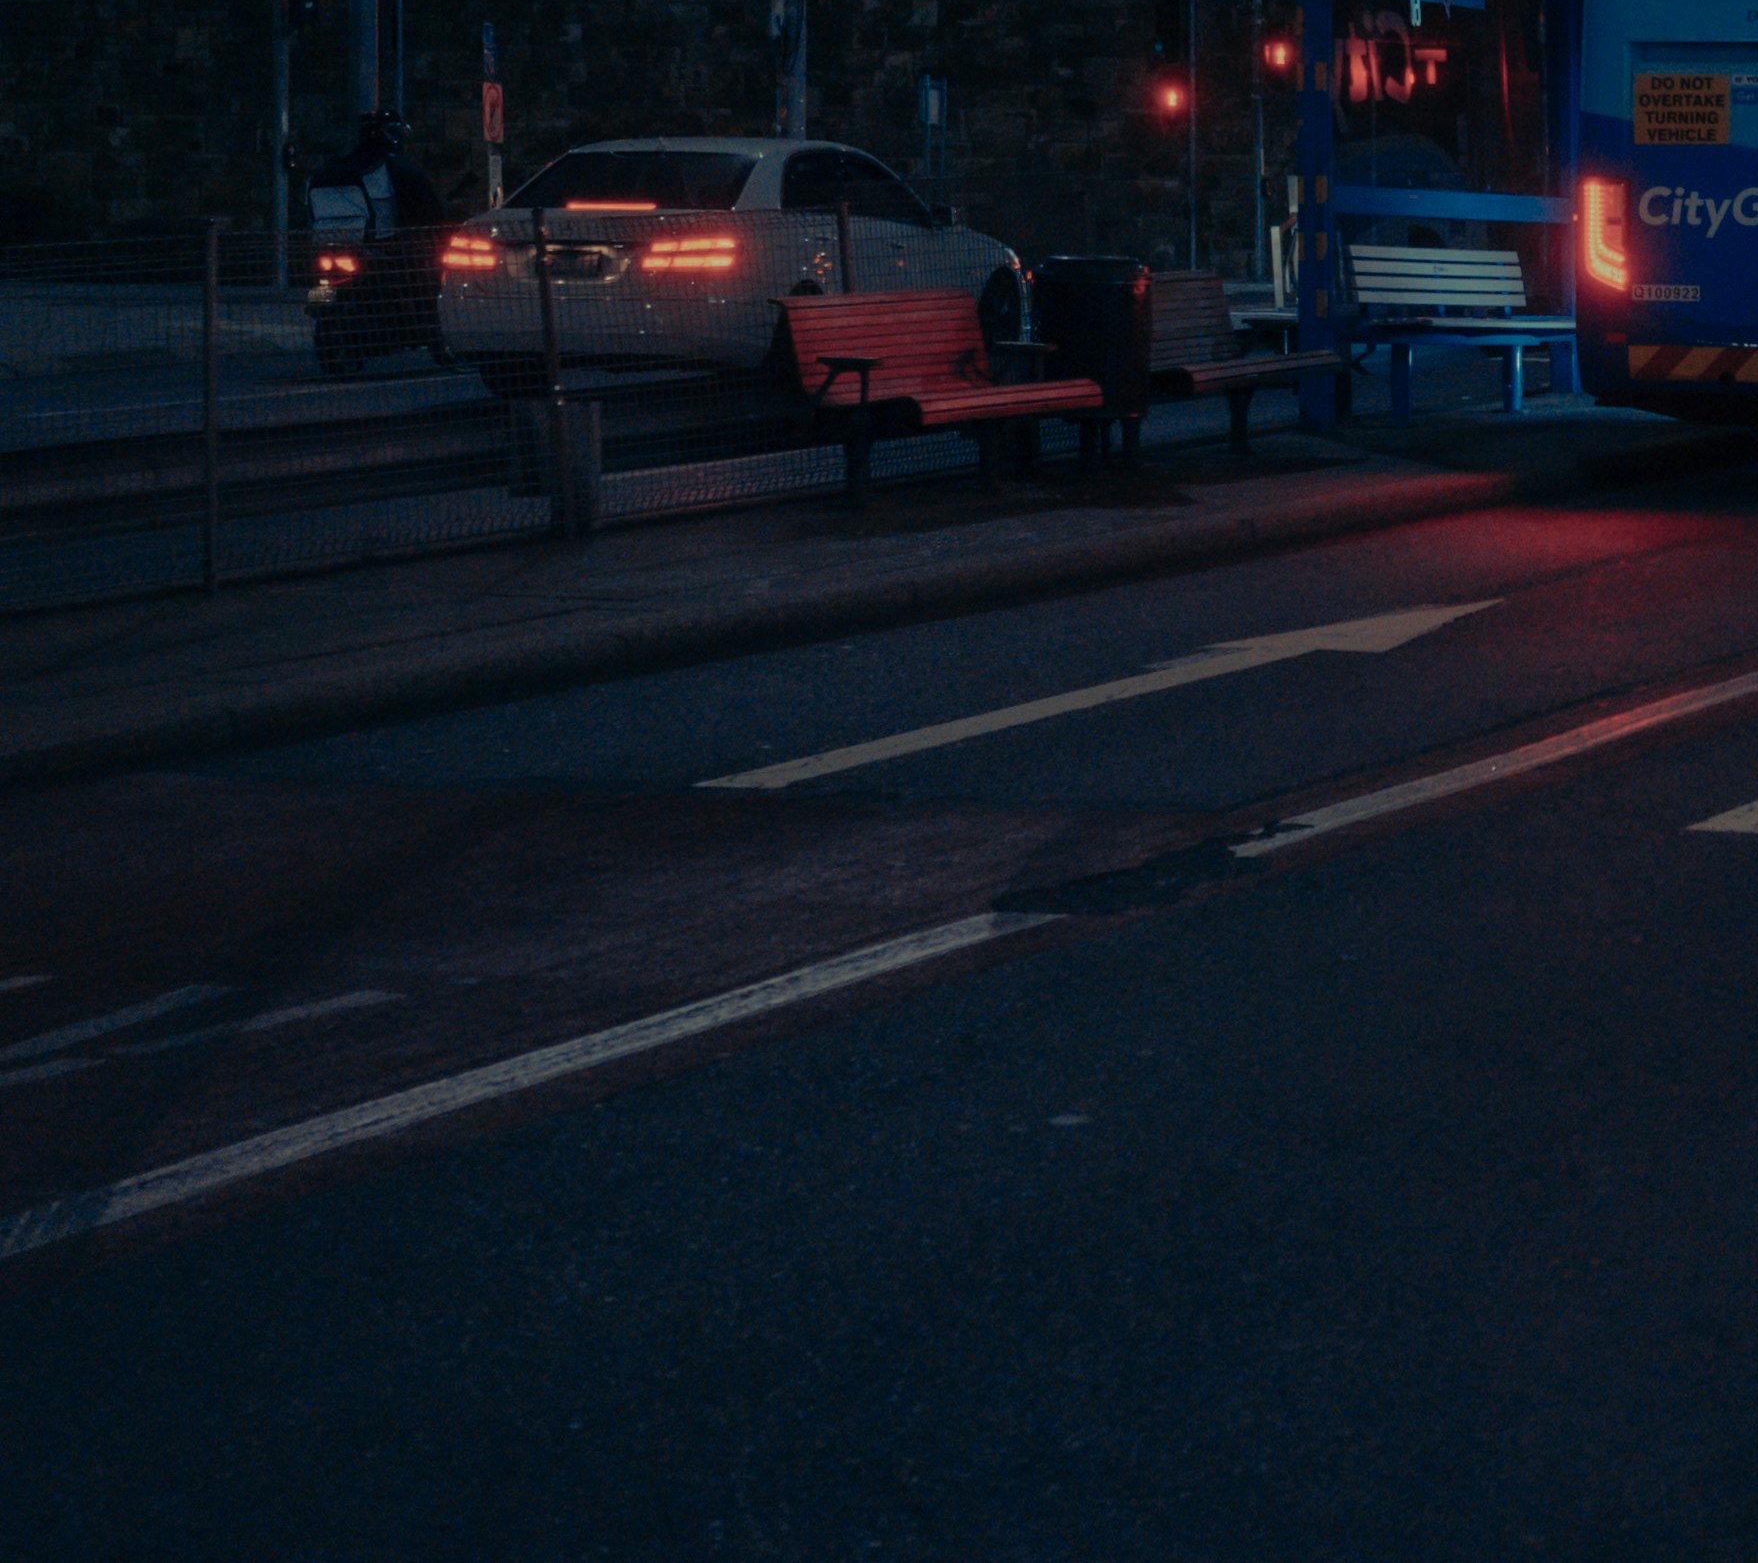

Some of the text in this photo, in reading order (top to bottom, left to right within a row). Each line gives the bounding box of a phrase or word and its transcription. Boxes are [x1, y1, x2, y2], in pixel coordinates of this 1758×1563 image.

[1651, 77, 1713, 90] DO NOT
[1639, 94, 1724, 107] OVERTAKE
[1645, 111, 1719, 124] TURNING
[1647, 129, 1717, 142] VEHICLE
[1634, 286, 1699, 299] Q100922
